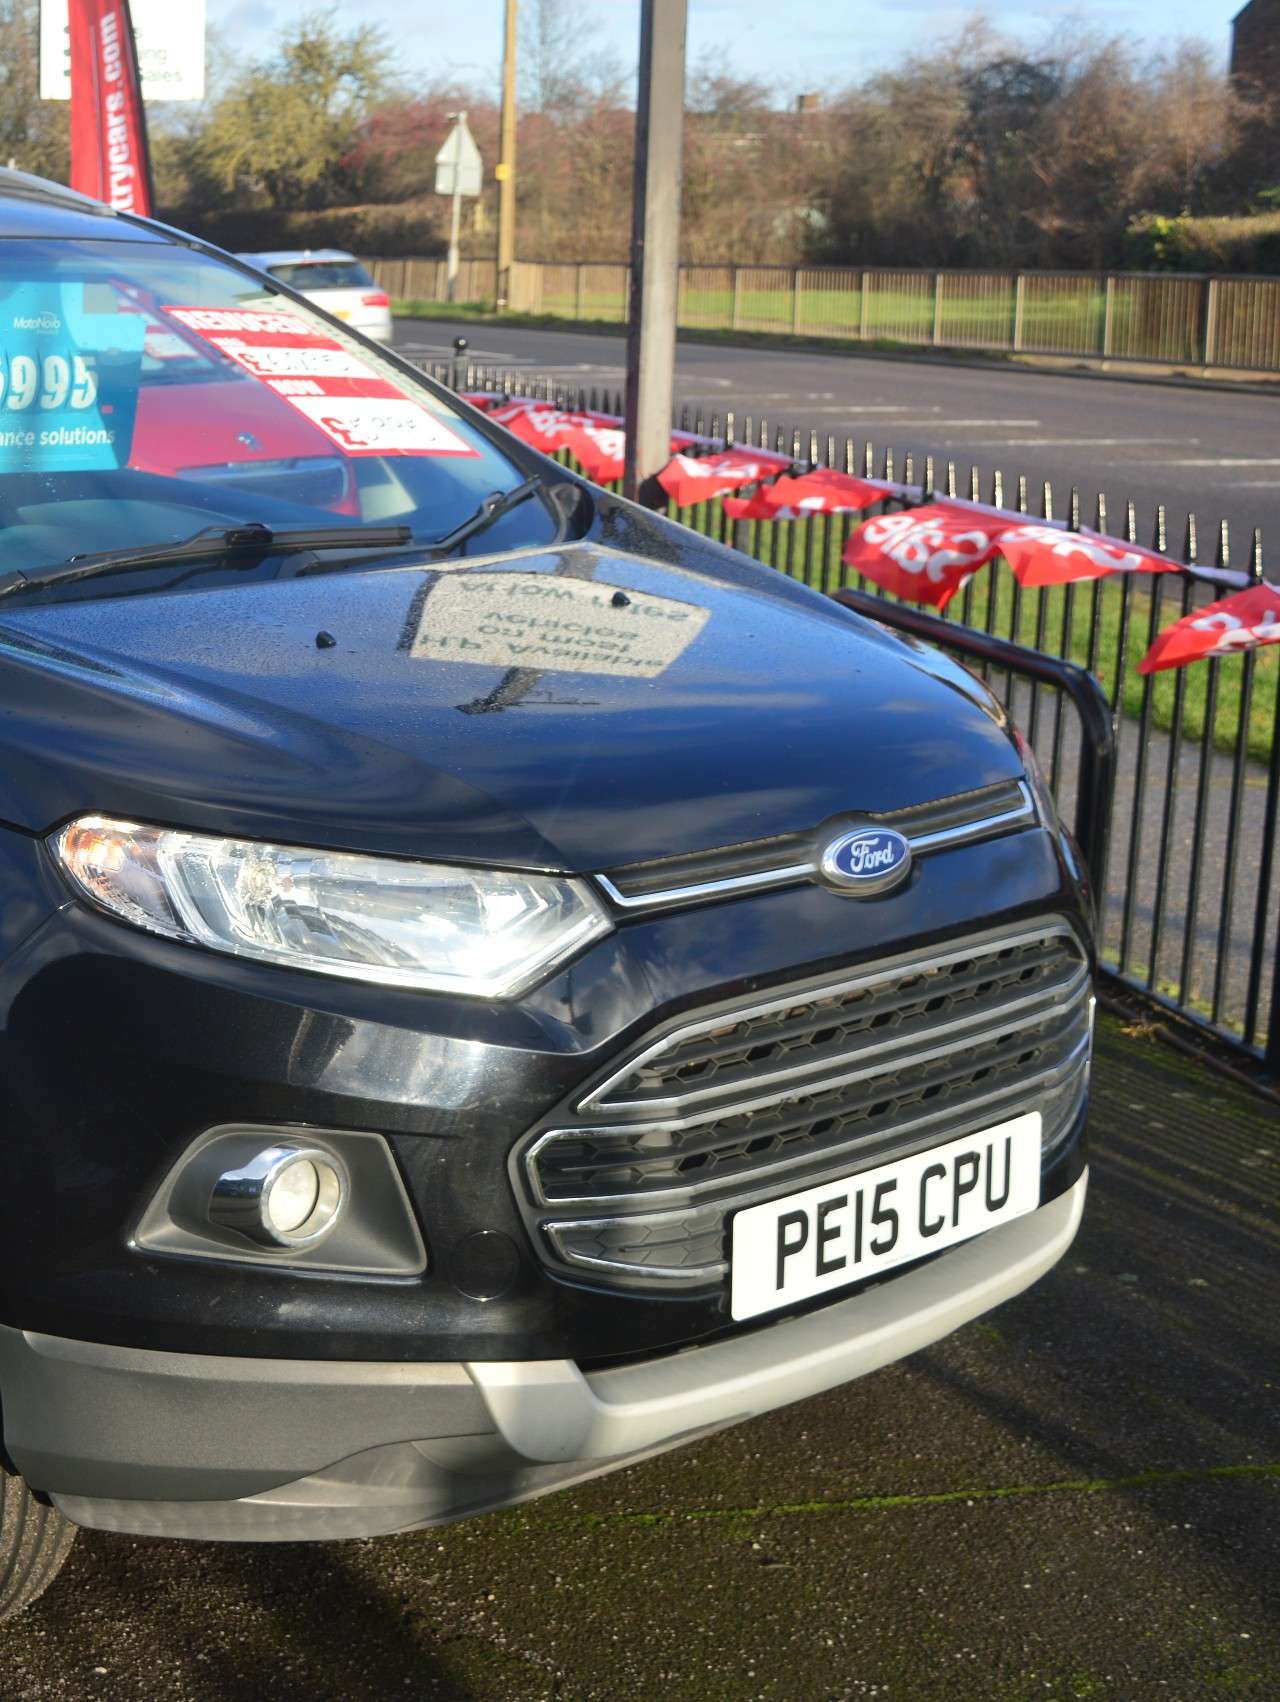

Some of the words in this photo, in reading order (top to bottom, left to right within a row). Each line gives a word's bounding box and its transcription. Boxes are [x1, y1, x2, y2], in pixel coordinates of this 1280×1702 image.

[39, 424, 116, 447] solutions
[850, 836, 894, 874] Ford
[776, 1177, 900, 1291] PE15
[919, 1136, 1012, 1238] CPU
